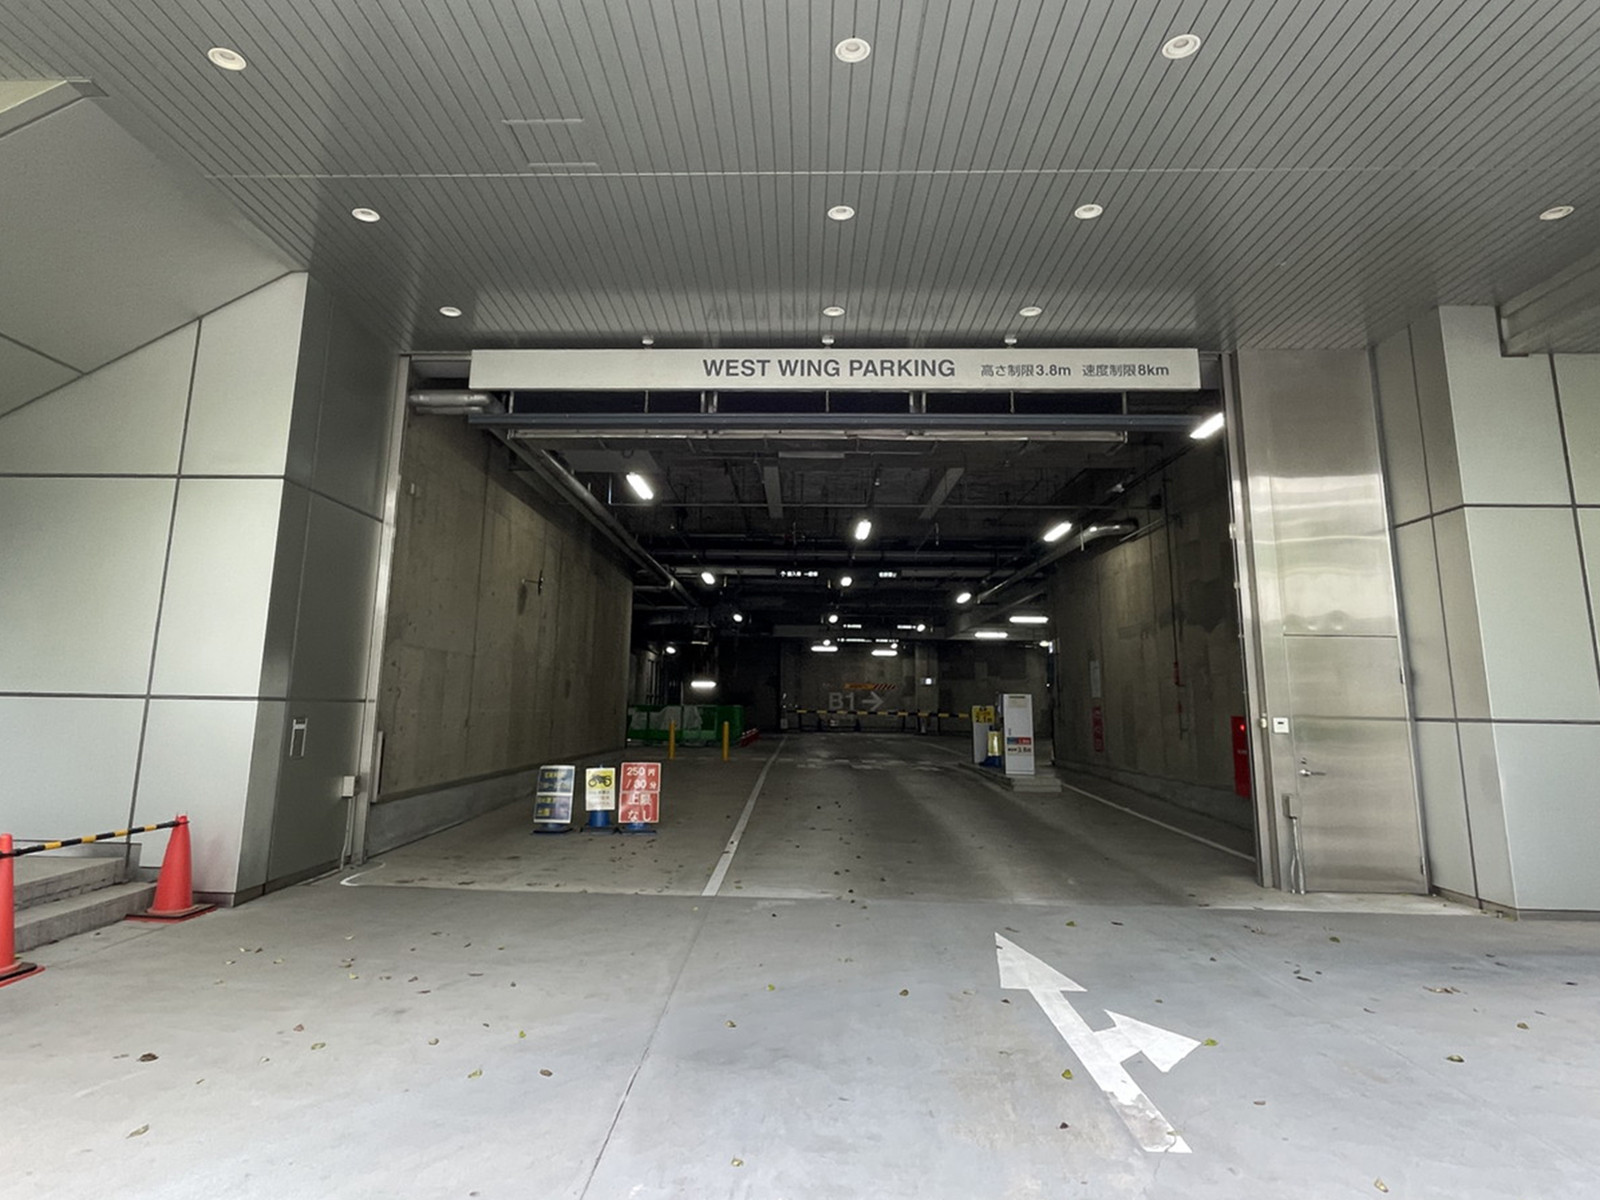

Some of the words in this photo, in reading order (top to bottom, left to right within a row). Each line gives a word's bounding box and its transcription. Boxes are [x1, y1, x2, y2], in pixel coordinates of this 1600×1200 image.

[703, 359, 771, 377] WEST
[778, 359, 840, 377] WING
[849, 359, 955, 377] PARKING
[980, 364, 1072, 377] 高さ制限3.8m
[1082, 364, 1170, 377] 速度制限8km
[828, 692, 855, 711] B1
[627, 809, 652, 822] なし
